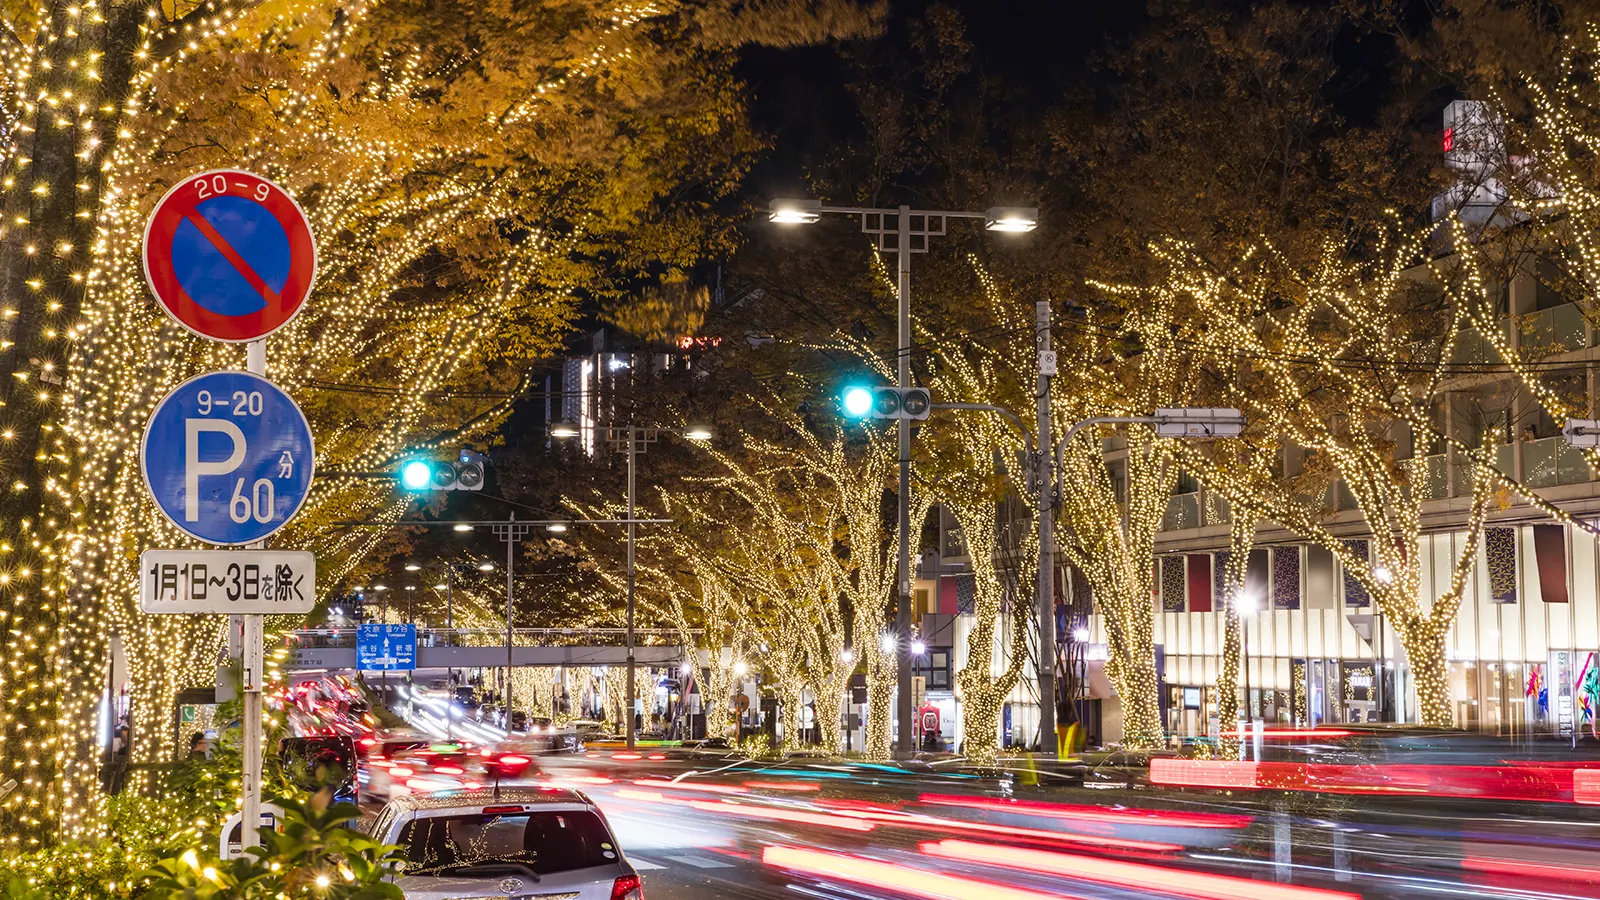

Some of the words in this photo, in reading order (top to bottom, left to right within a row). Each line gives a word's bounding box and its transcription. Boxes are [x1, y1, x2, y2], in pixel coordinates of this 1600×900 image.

[194, 175, 270, 202] 20-9
[197, 390, 263, 416] 9-20
[185, 418, 247, 522] P
[278, 451, 294, 479] 分
[229, 477, 274, 524] 60
